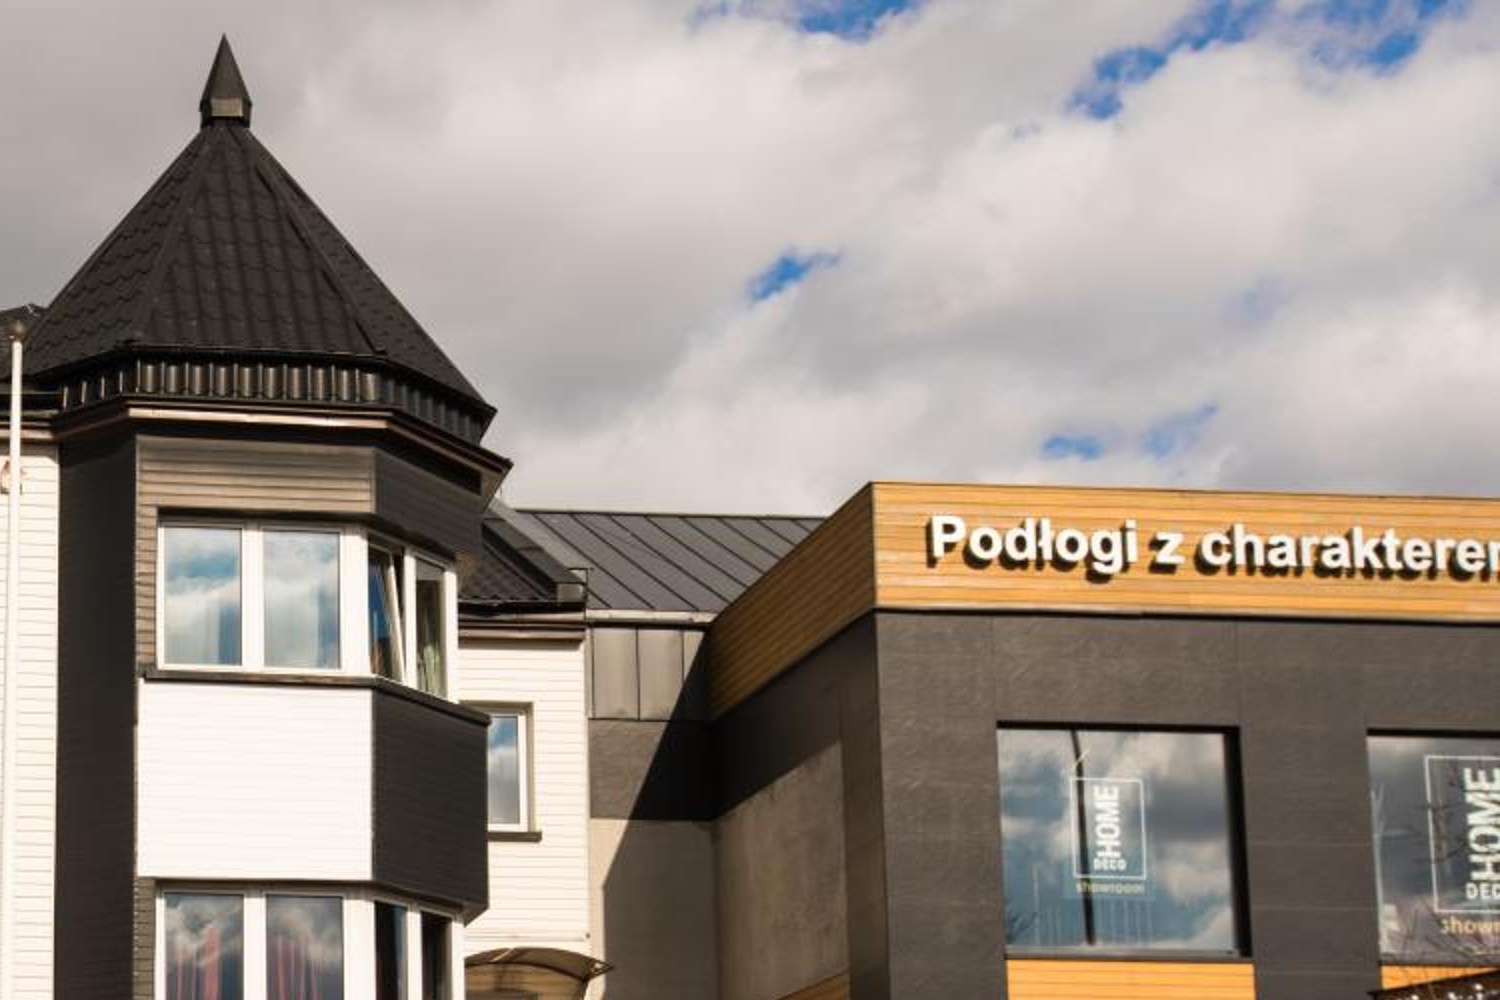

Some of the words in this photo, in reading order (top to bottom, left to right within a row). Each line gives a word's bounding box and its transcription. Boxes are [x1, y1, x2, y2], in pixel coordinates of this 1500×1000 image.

[931, 515, 1138, 575] Podłogi
[1156, 531, 1186, 563] z
[1093, 785, 1121, 857] HOME
[1464, 768, 1500, 880] HOME
